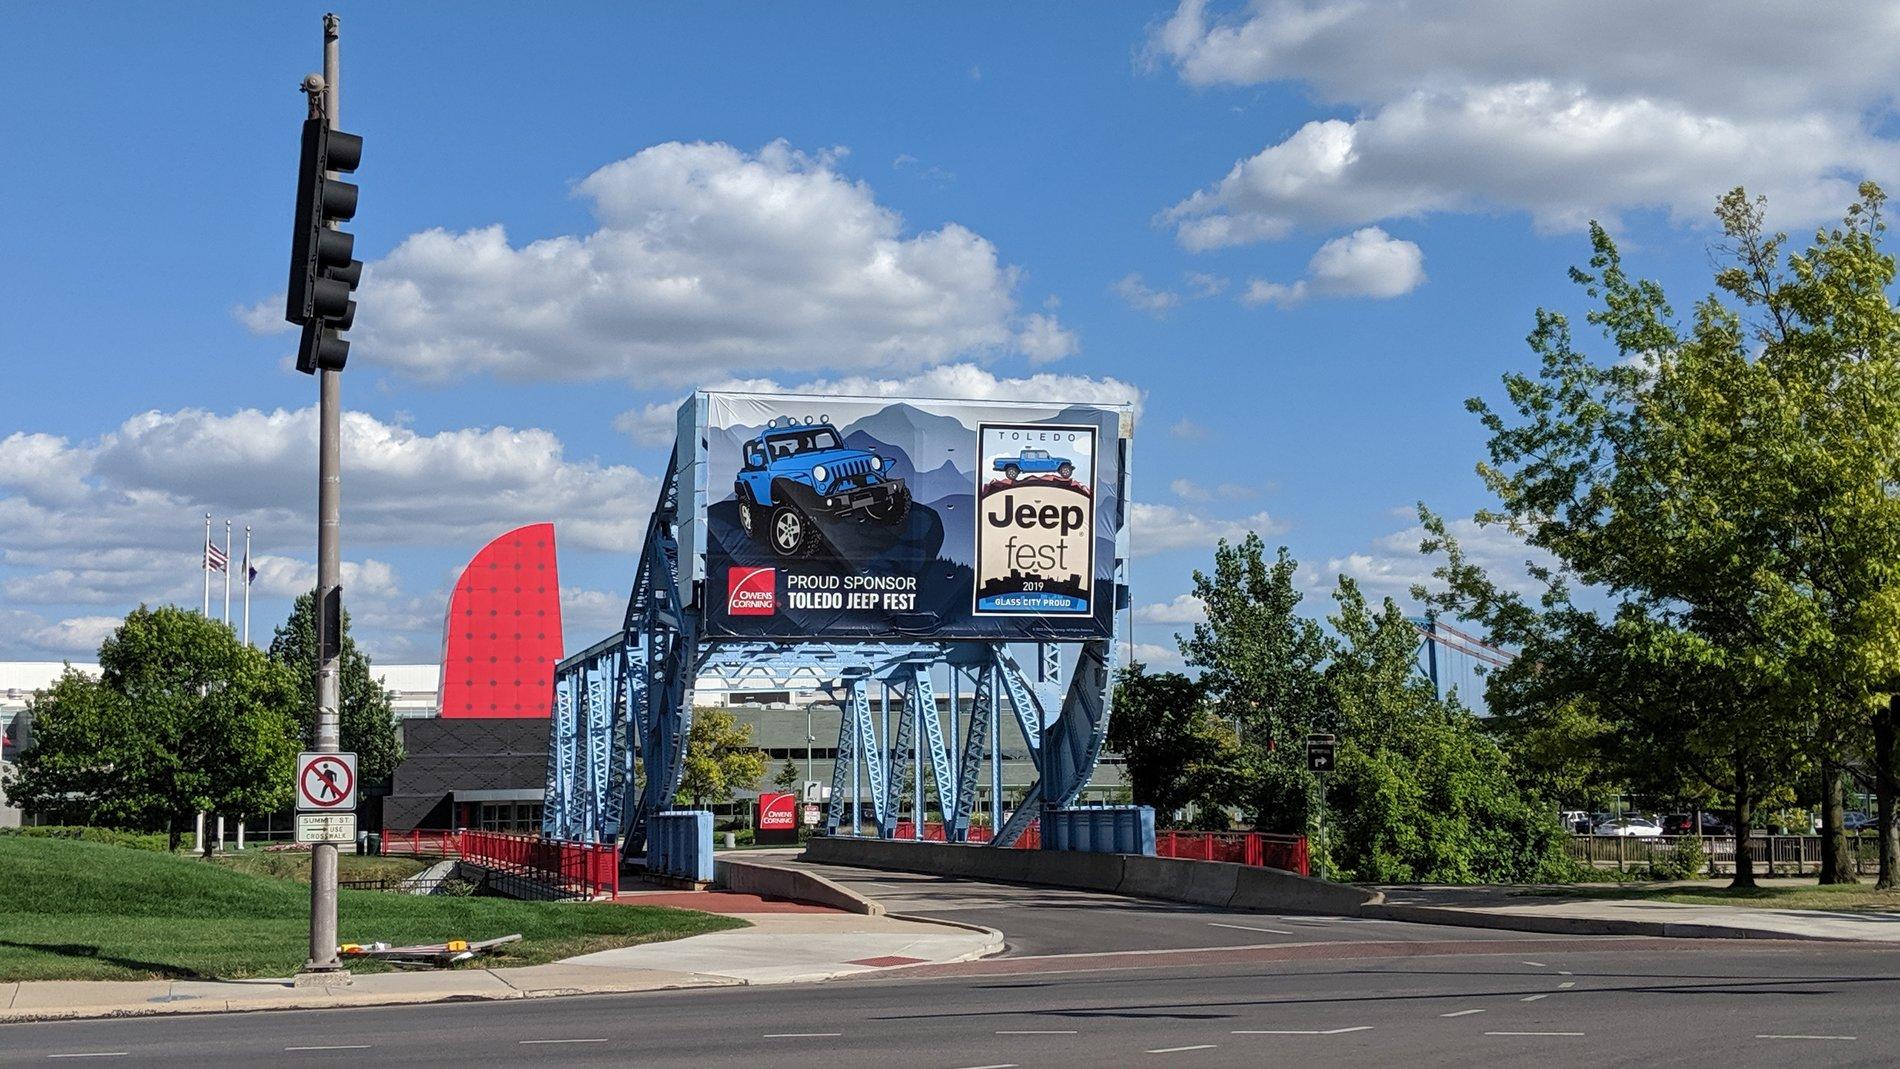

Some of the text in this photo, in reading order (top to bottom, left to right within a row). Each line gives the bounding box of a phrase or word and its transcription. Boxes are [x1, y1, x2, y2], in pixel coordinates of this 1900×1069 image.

[999, 431, 1076, 442] TOLEDO
[988, 495, 1084, 536] Jeep
[1005, 536, 1068, 570] fest
[787, 575, 917, 590] PROUD SPONSOR
[1022, 581, 1044, 591] 2019
[732, 600, 773, 609] CORNING
[787, 592, 917, 610] TOLEDO JEEP FEST
[994, 598, 1071, 607] GLASS CITY PROUD
